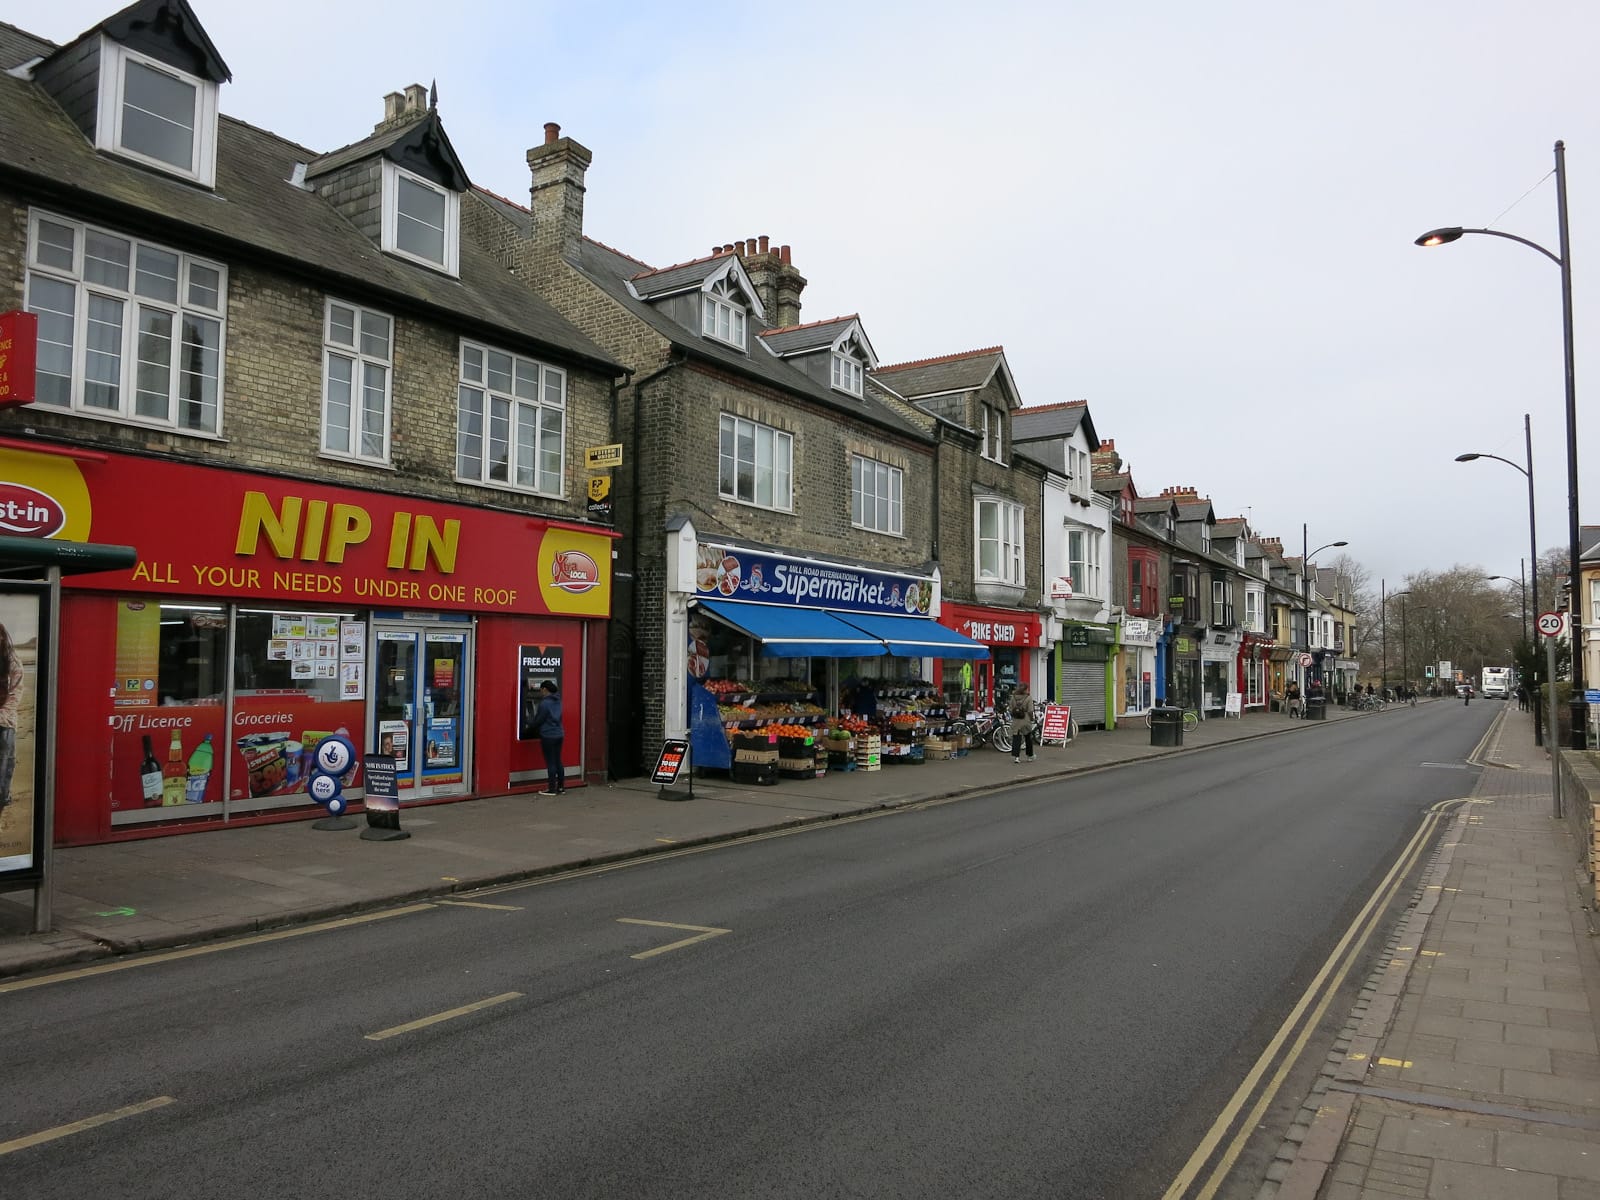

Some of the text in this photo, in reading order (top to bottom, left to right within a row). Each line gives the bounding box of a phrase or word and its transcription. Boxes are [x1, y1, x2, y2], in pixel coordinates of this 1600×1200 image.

[235, 491, 461, 574] NIP IN
[570, 571, 587, 579] LOCAL
[803, 567, 820, 577] ROAD
[820, 570, 860, 582] INTERNATIONAL
[132, 561, 517, 606] ALL YOUR NEEDS UNDER ONE ROOF
[772, 564, 885, 604] Supermarket
[1541, 618, 1559, 628] 20
[971, 621, 991, 640] BIKE
[993, 623, 1015, 642] SHED
[523, 657, 561, 667] FREE CASH
[113, 714, 192, 732] Off Licence
[234, 711, 294, 726] Groceries
